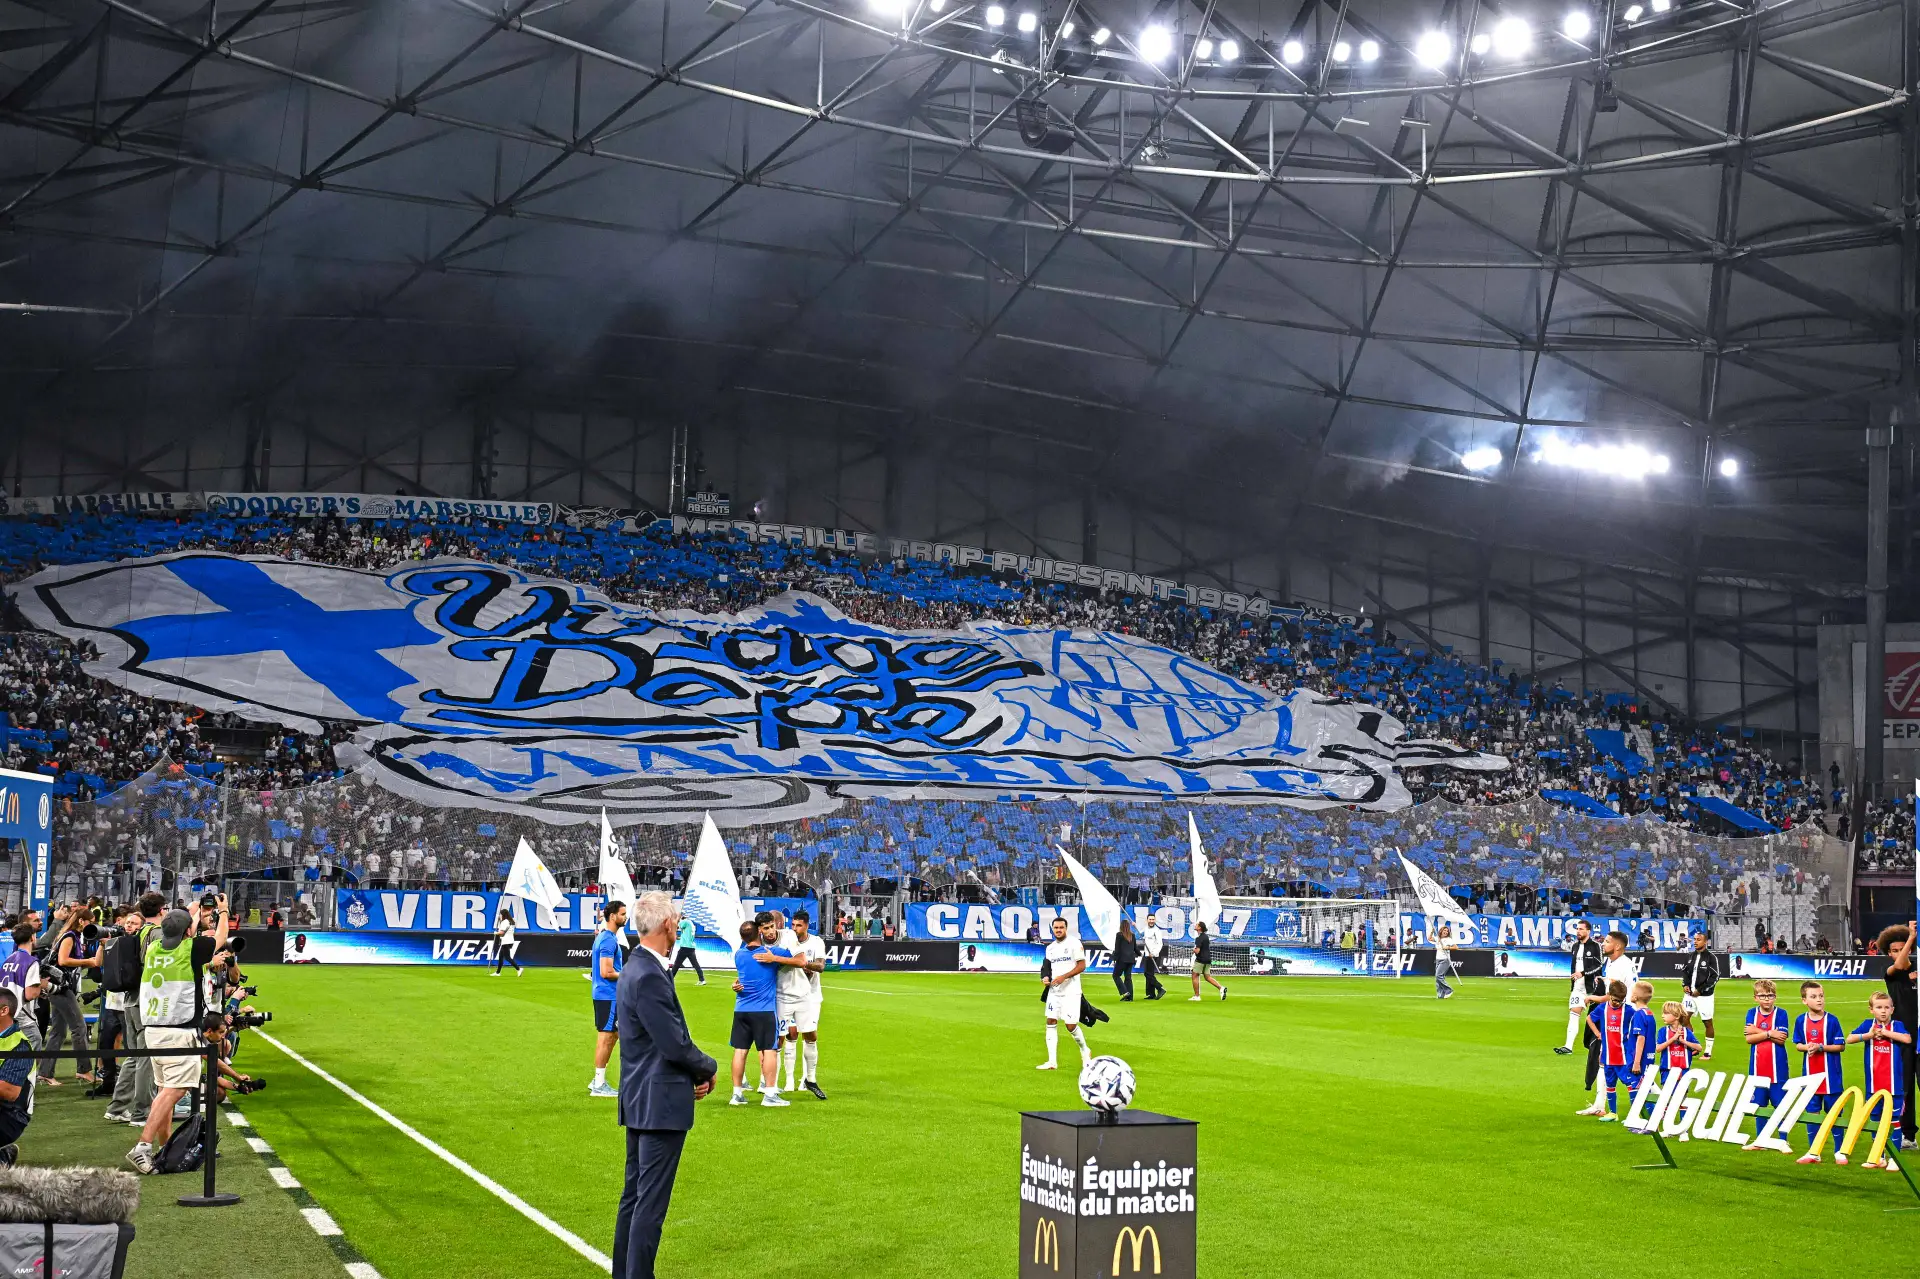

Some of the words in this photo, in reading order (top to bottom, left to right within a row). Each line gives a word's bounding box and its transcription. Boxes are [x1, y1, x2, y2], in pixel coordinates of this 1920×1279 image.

[695, 492, 719, 503] AUX
[226, 496, 360, 515] DODGER'S
[395, 499, 537, 525] MARSEILLE
[687, 503, 730, 514] ABSENTS
[992, 550, 1174, 599] PUISSANT
[1184, 584, 1270, 619] 1994
[1883, 723, 1920, 739] EP
[926, 903, 1080, 940] CAOM
[147, 955, 174, 969] LFP
[885, 953, 920, 962] TIMOTHY
[1162, 957, 1193, 967] UNIB
[1814, 958, 1867, 976] WEAH
[1570, 996, 1580, 1005] 23
[1685, 1000, 1693, 1008] 14
[1021, 1143, 1076, 1190] Équipier
[1082, 1156, 1194, 1196] Équipier
[1020, 1178, 1036, 1201] du
[1037, 1186, 1076, 1216] match
[1079, 1192, 1112, 1217] du
[1116, 1188, 1195, 1215] match
